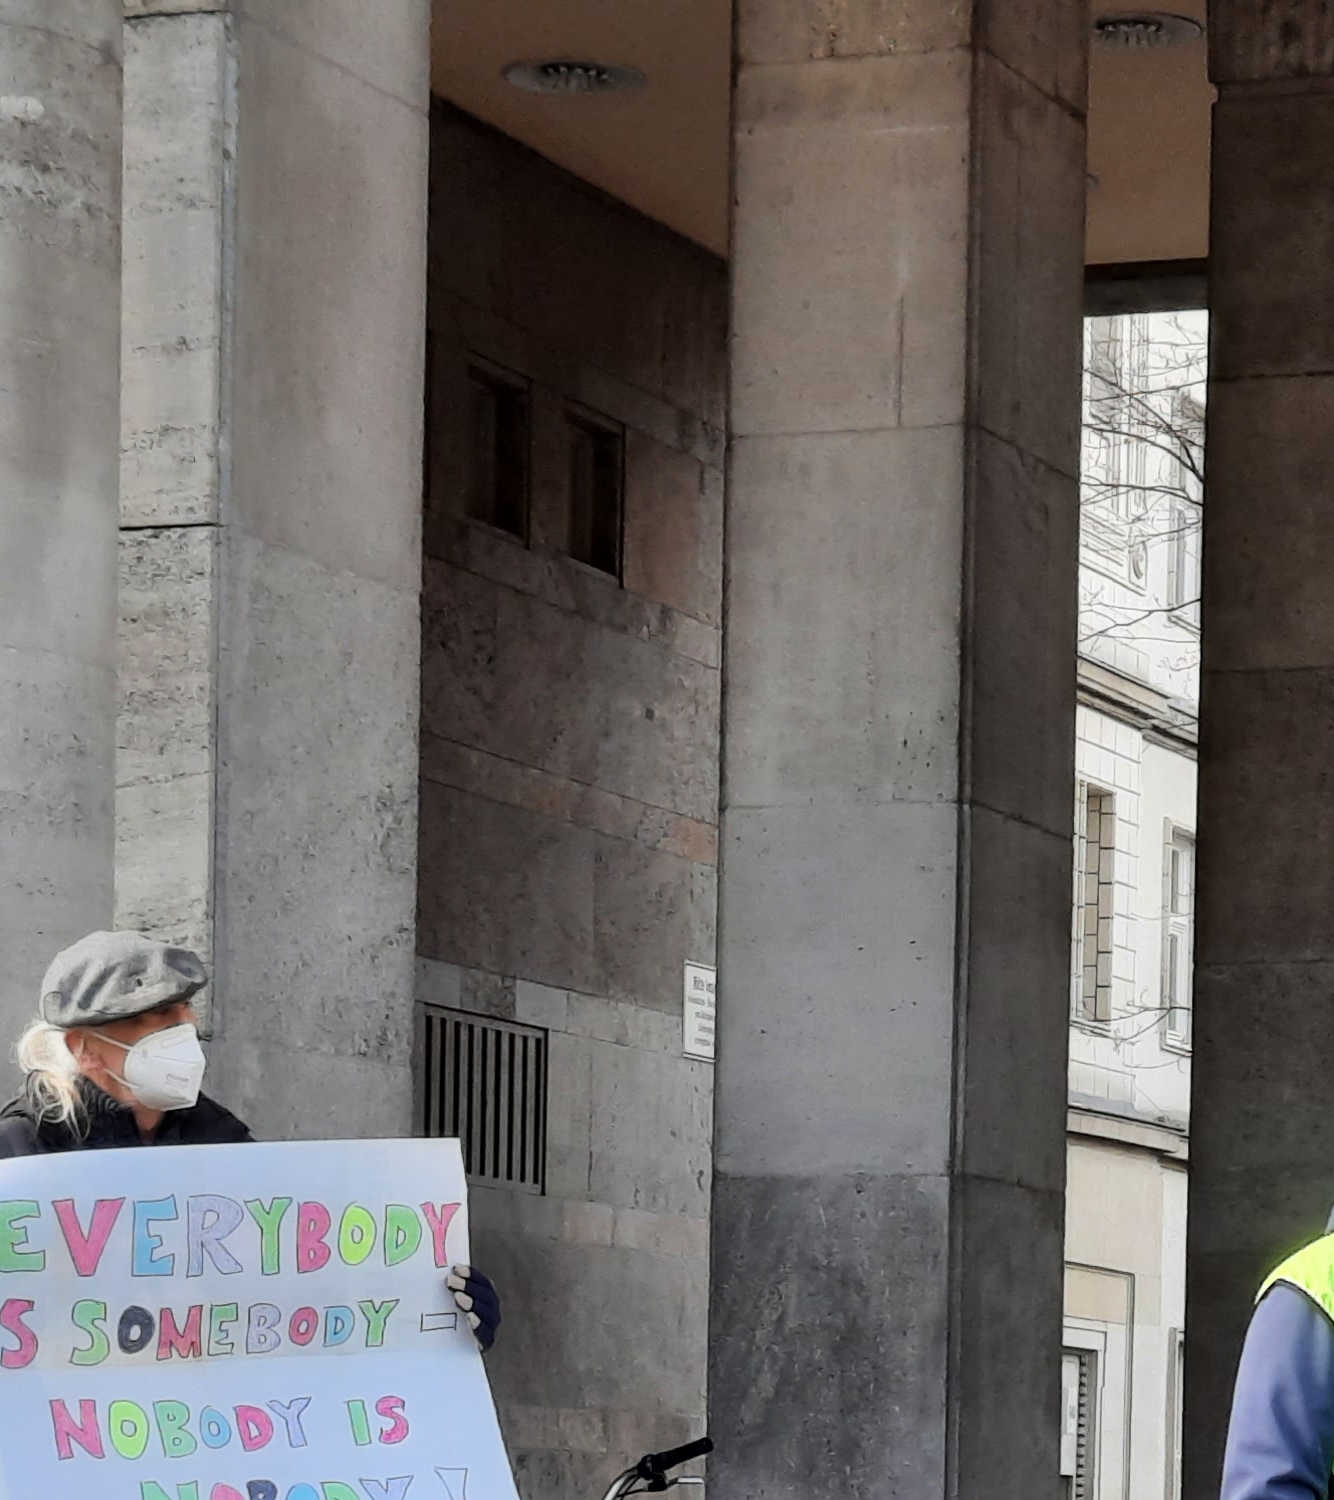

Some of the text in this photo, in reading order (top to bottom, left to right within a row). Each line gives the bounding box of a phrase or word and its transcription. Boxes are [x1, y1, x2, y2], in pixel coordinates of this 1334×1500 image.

[69, 1298, 401, 1366] SOMEBODY
[49, 1395, 410, 1459] NOBODY IS
